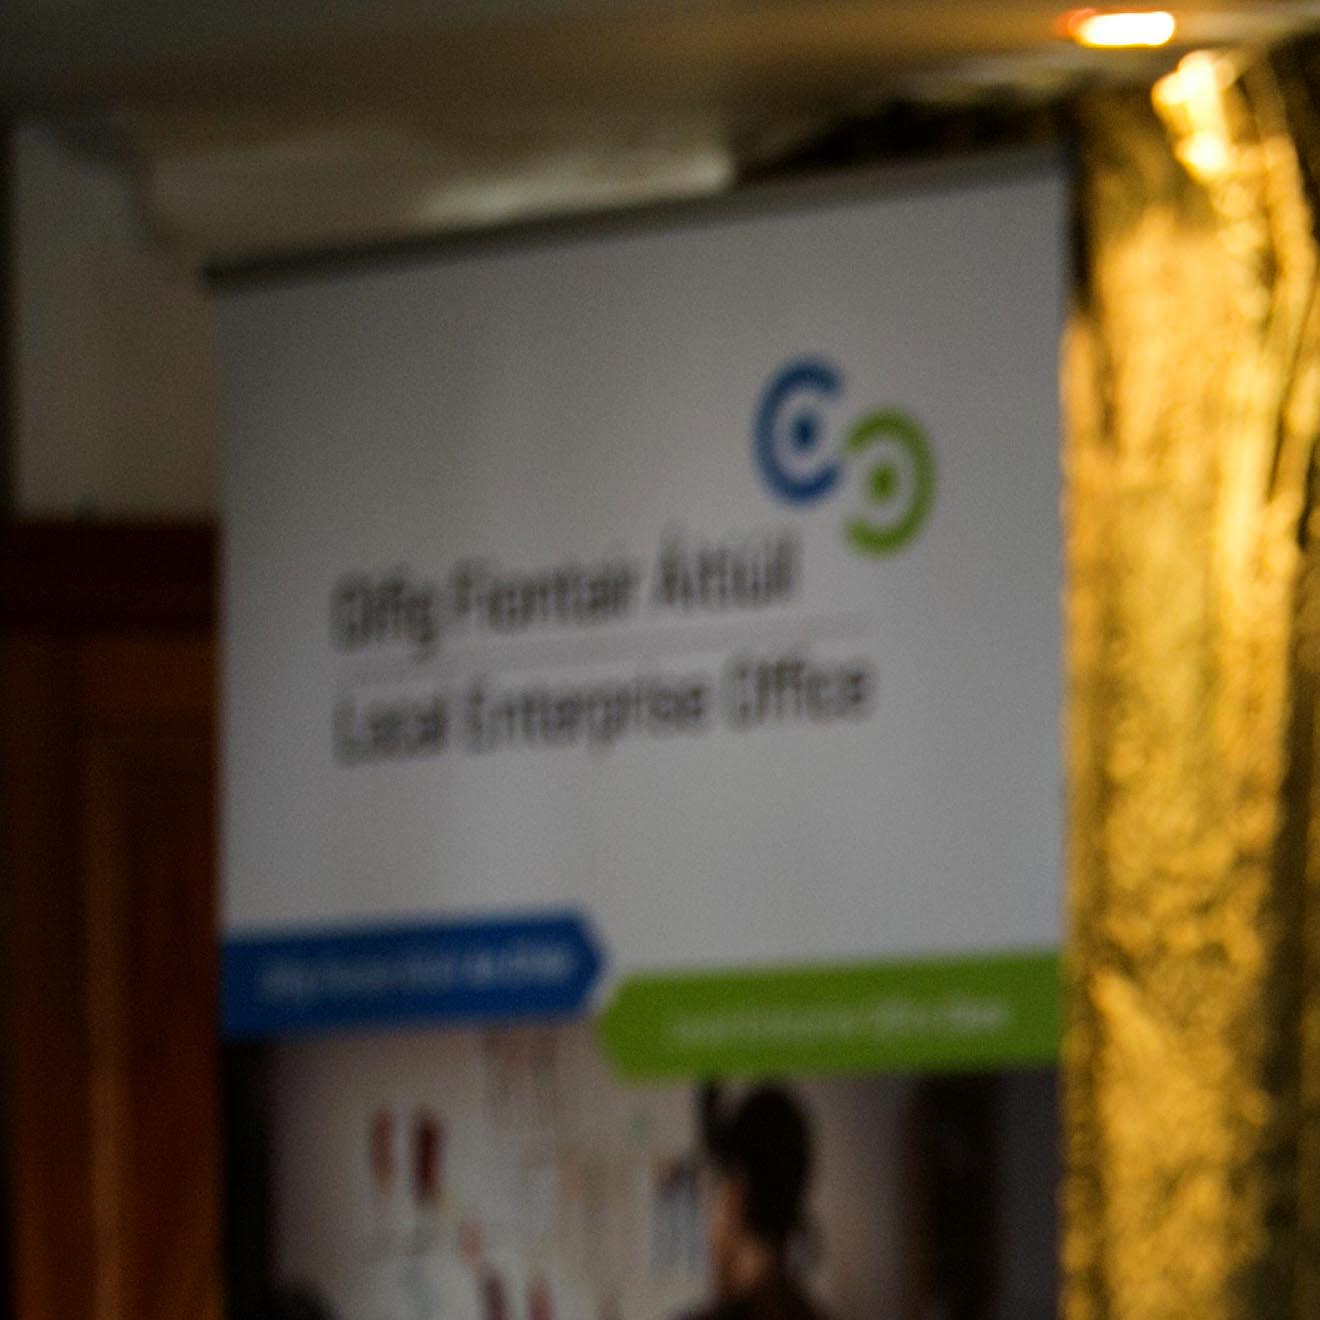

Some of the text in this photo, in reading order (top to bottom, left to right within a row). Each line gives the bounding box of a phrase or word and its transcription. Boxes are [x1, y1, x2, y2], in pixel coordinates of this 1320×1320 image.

[332, 645, 880, 768] Local Enterprise Office
